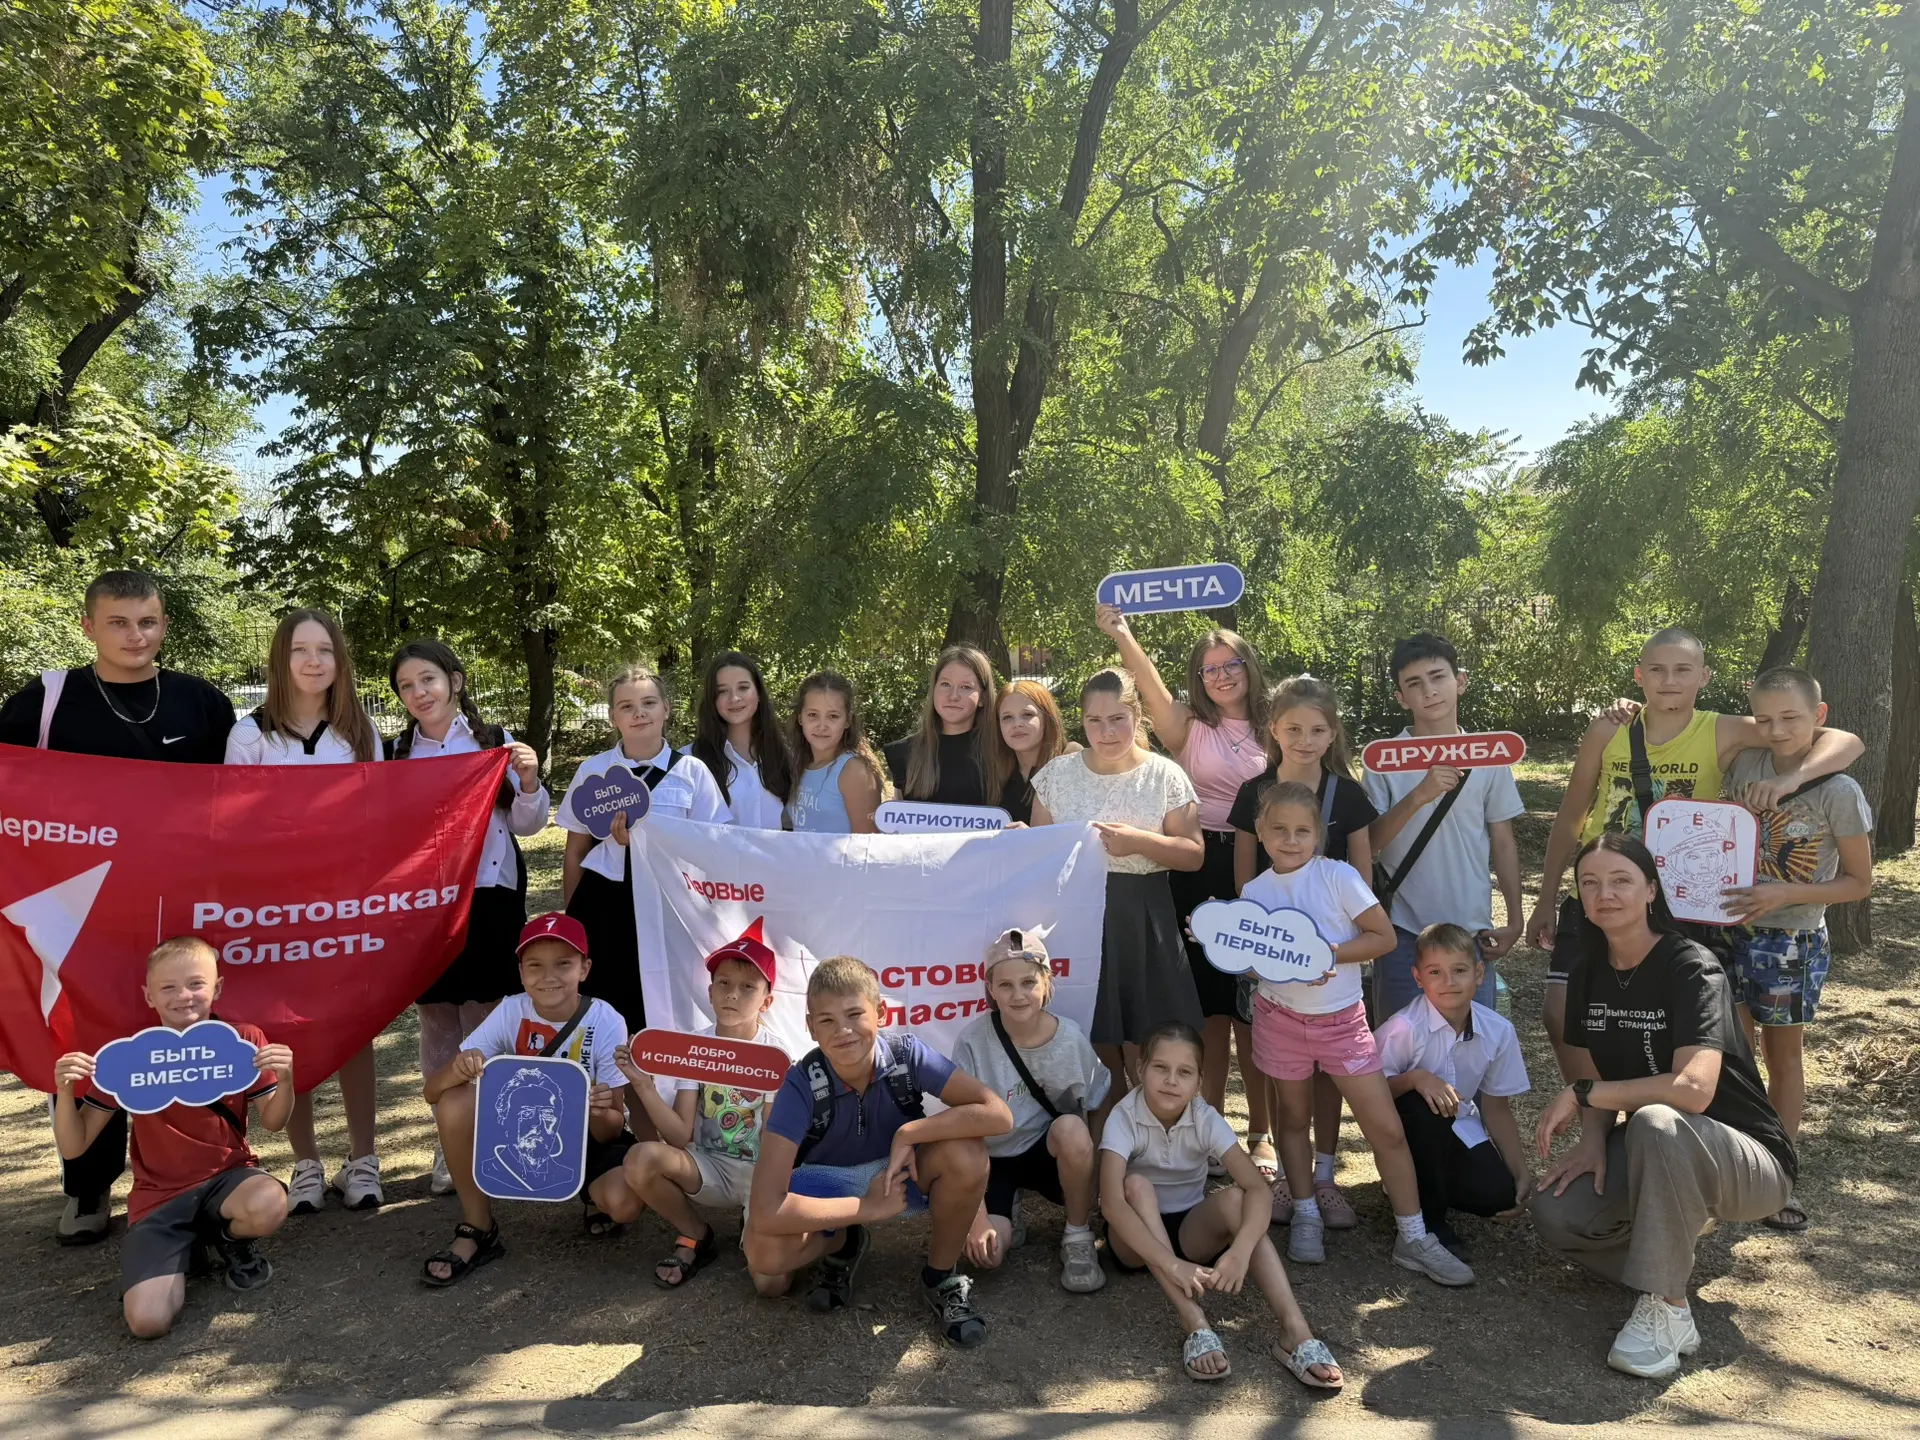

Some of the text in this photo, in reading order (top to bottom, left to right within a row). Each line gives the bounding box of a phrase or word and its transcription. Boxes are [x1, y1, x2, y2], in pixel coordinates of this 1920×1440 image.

[1113, 575, 1226, 605] МЕЧТА
[1376, 741, 1511, 768] ДРУЖБА
[1611, 761, 1699, 774] NE WORLD
[594, 784, 622, 800] БЫТЬ
[583, 792, 641, 819] С РОССИЕЙ!
[884, 811, 1002, 830] ПАТРИОТИЗМ
[682, 871, 765, 905] Первые
[192, 884, 461, 930] Ростовская
[1238, 918, 1295, 943] БЫТЬ
[214, 932, 386, 966] бласть
[1214, 931, 1311, 968] ПЕРВЫМ!
[1618, 1020, 1667, 1031] СТРАНИЦЫ
[1629, 1008, 1666, 1020] СОЗДЙ
[150, 1046, 216, 1065] БЫТЬ
[641, 1050, 780, 1080] И СПРАВЕДЛИВОСТЬ
[687, 1045, 737, 1060] ДОБРО
[130, 1064, 234, 1088] ВМЕСТЕ!
